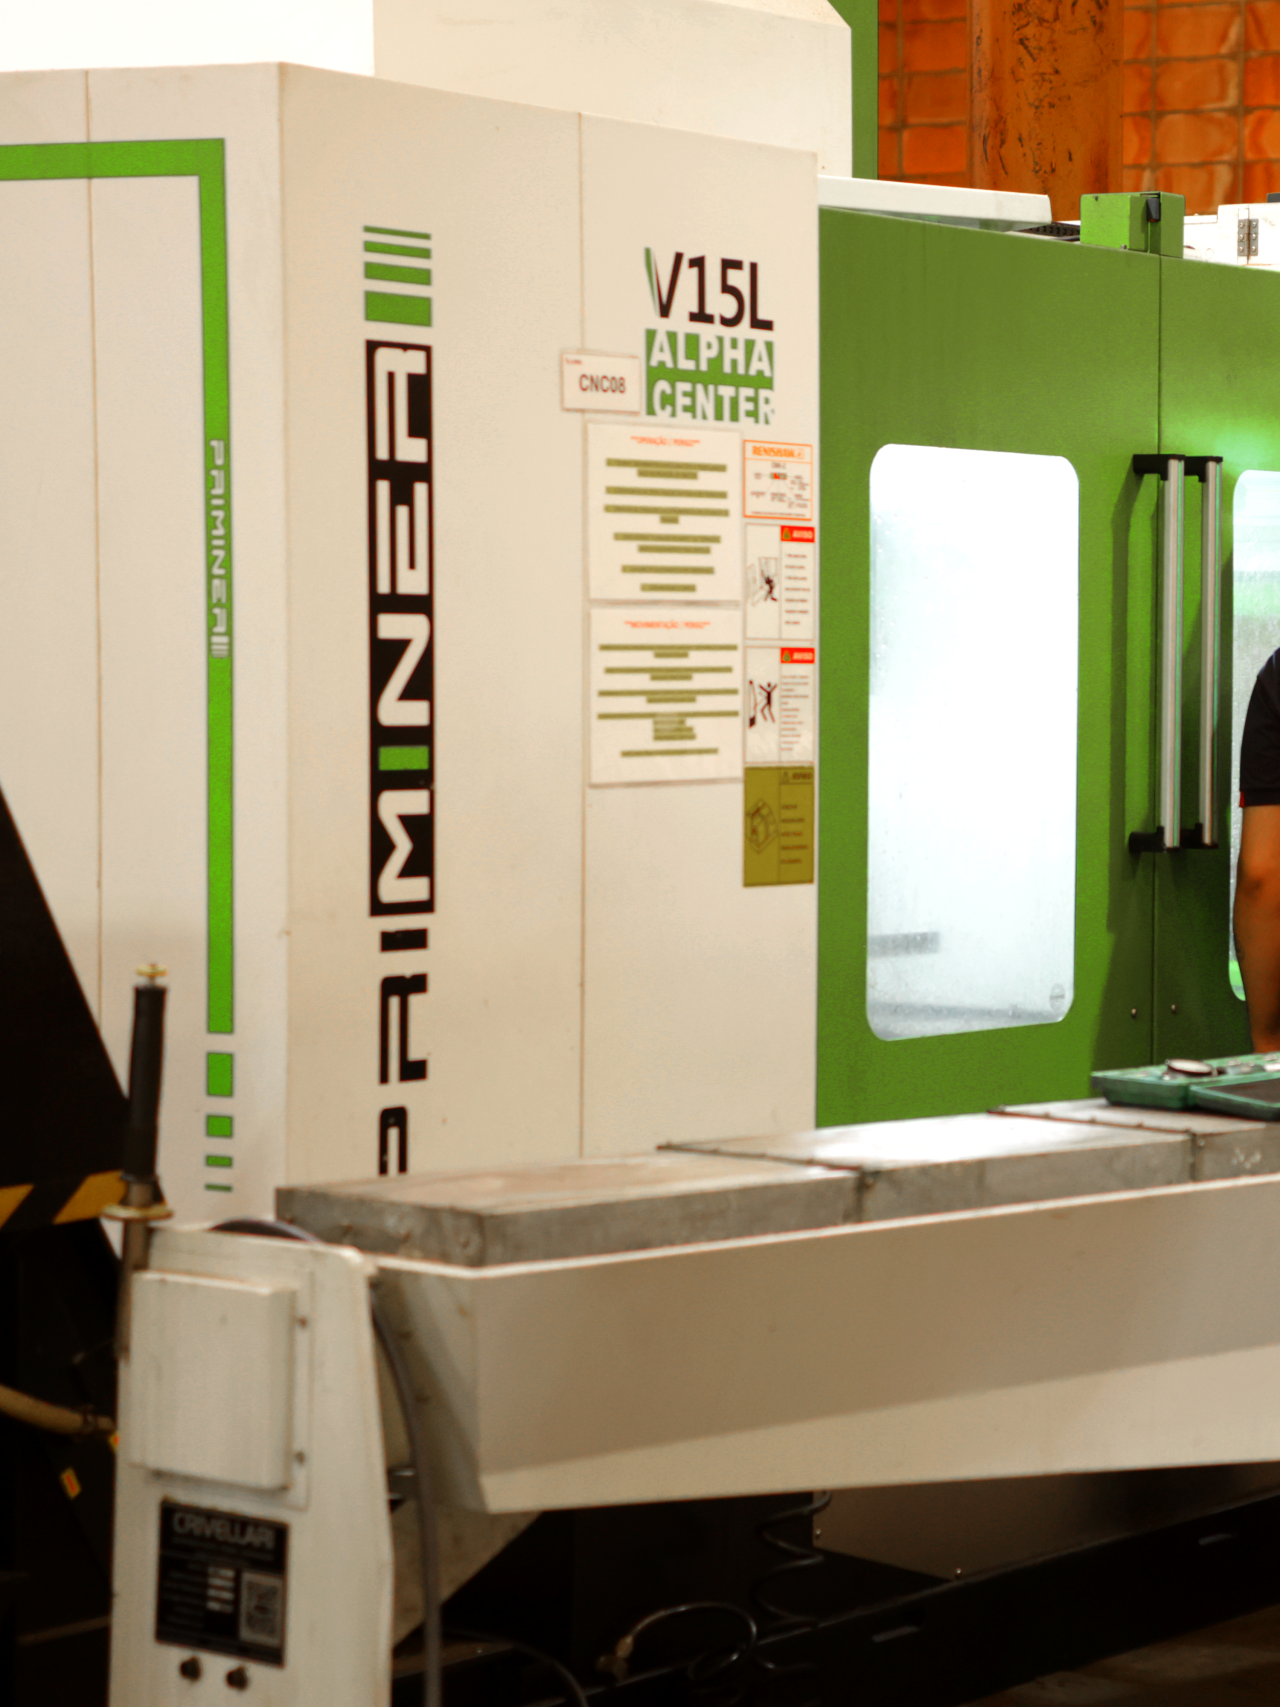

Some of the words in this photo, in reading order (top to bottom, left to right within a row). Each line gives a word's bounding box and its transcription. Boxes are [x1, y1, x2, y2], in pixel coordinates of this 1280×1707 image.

[644, 247, 774, 332] V15L
[648, 329, 774, 379] ALPHA
[578, 373, 627, 394] CNC08
[651, 379, 775, 425] CENTER
[792, 651, 814, 661] AVISO
[172, 1511, 276, 1551] CRIVELLARI
